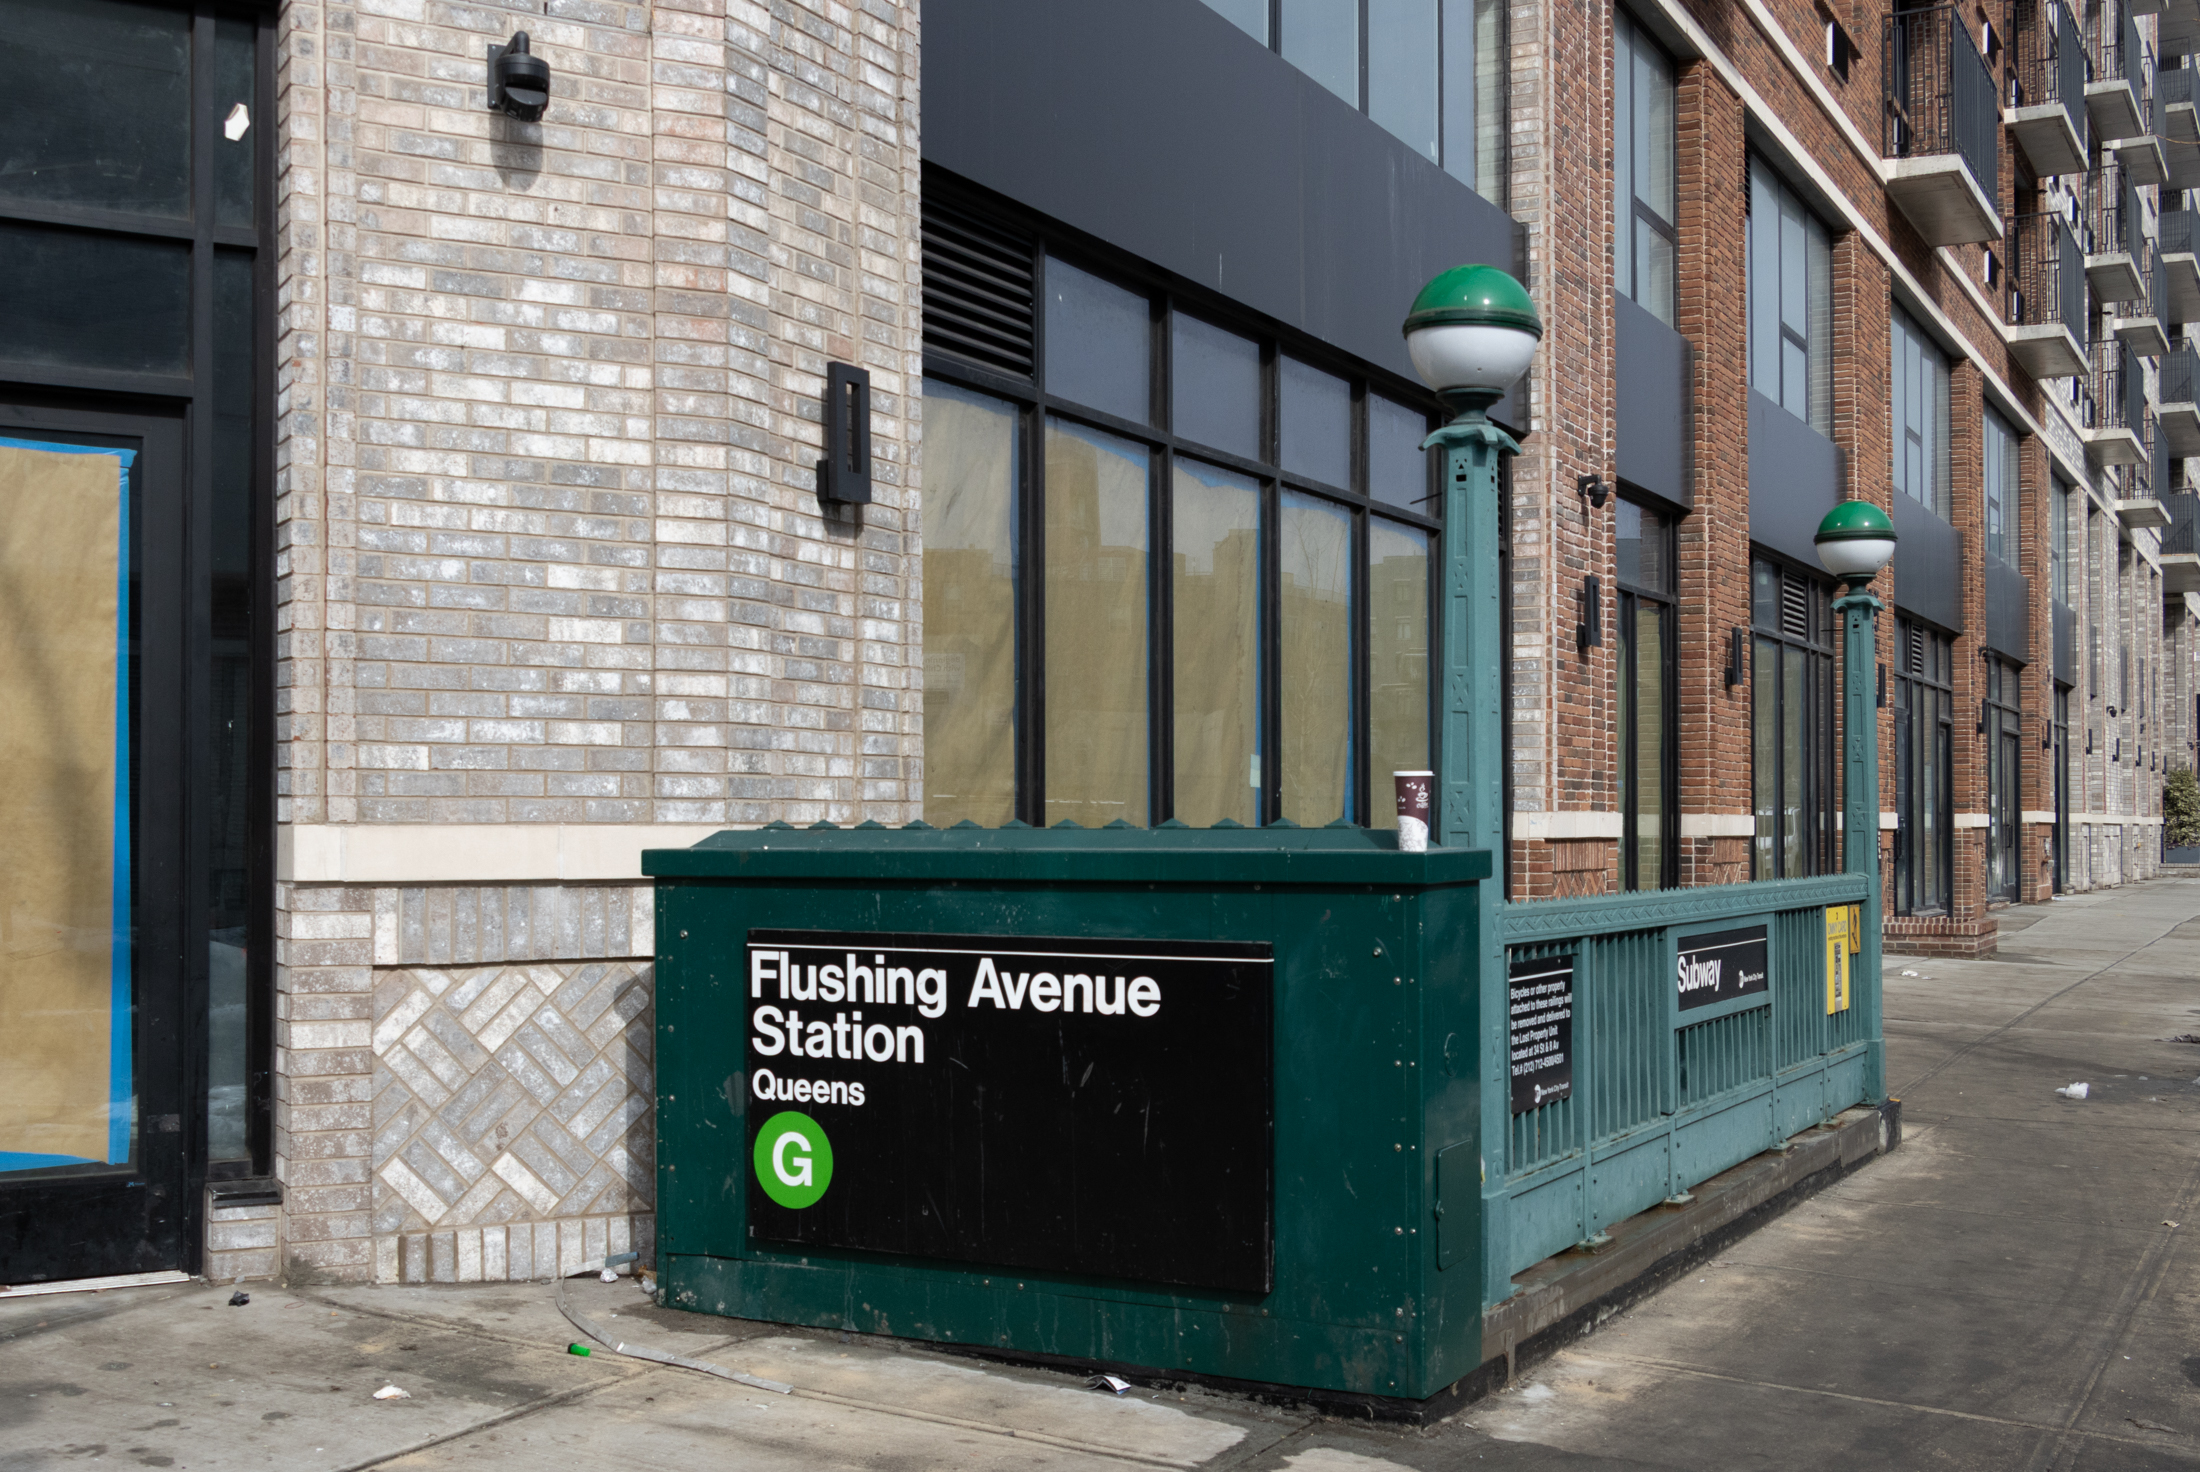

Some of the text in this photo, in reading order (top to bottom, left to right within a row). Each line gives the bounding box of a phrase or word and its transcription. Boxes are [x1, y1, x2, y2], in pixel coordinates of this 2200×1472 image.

[751, 950, 1162, 1019] Flushing Avenue
[1677, 954, 1721, 993] Subway
[1511, 980, 1566, 1001] Bicycles or other property
[1511, 992, 1572, 1015] attached to these railings will
[1511, 1008, 1571, 1030] be removed and delivered to
[752, 1005, 925, 1064] Station
[1511, 1024, 1558, 1046] the Lost Property Unit
[1511, 1046, 1528, 1061] located
[1529, 1046, 1533, 1057] at
[1534, 1044, 1539, 1055] 34
[1540, 1042, 1545, 1054] St
[1545, 1041, 1549, 1053] &
[1553, 1039, 1559, 1050] Av
[1511, 1063, 1523, 1077] Tel.#
[1523, 1060, 1534, 1076] (212)
[752, 1068, 866, 1107] Queens
[1559, 1081, 1569, 1090] Transit
[772, 1131, 813, 1187] G
